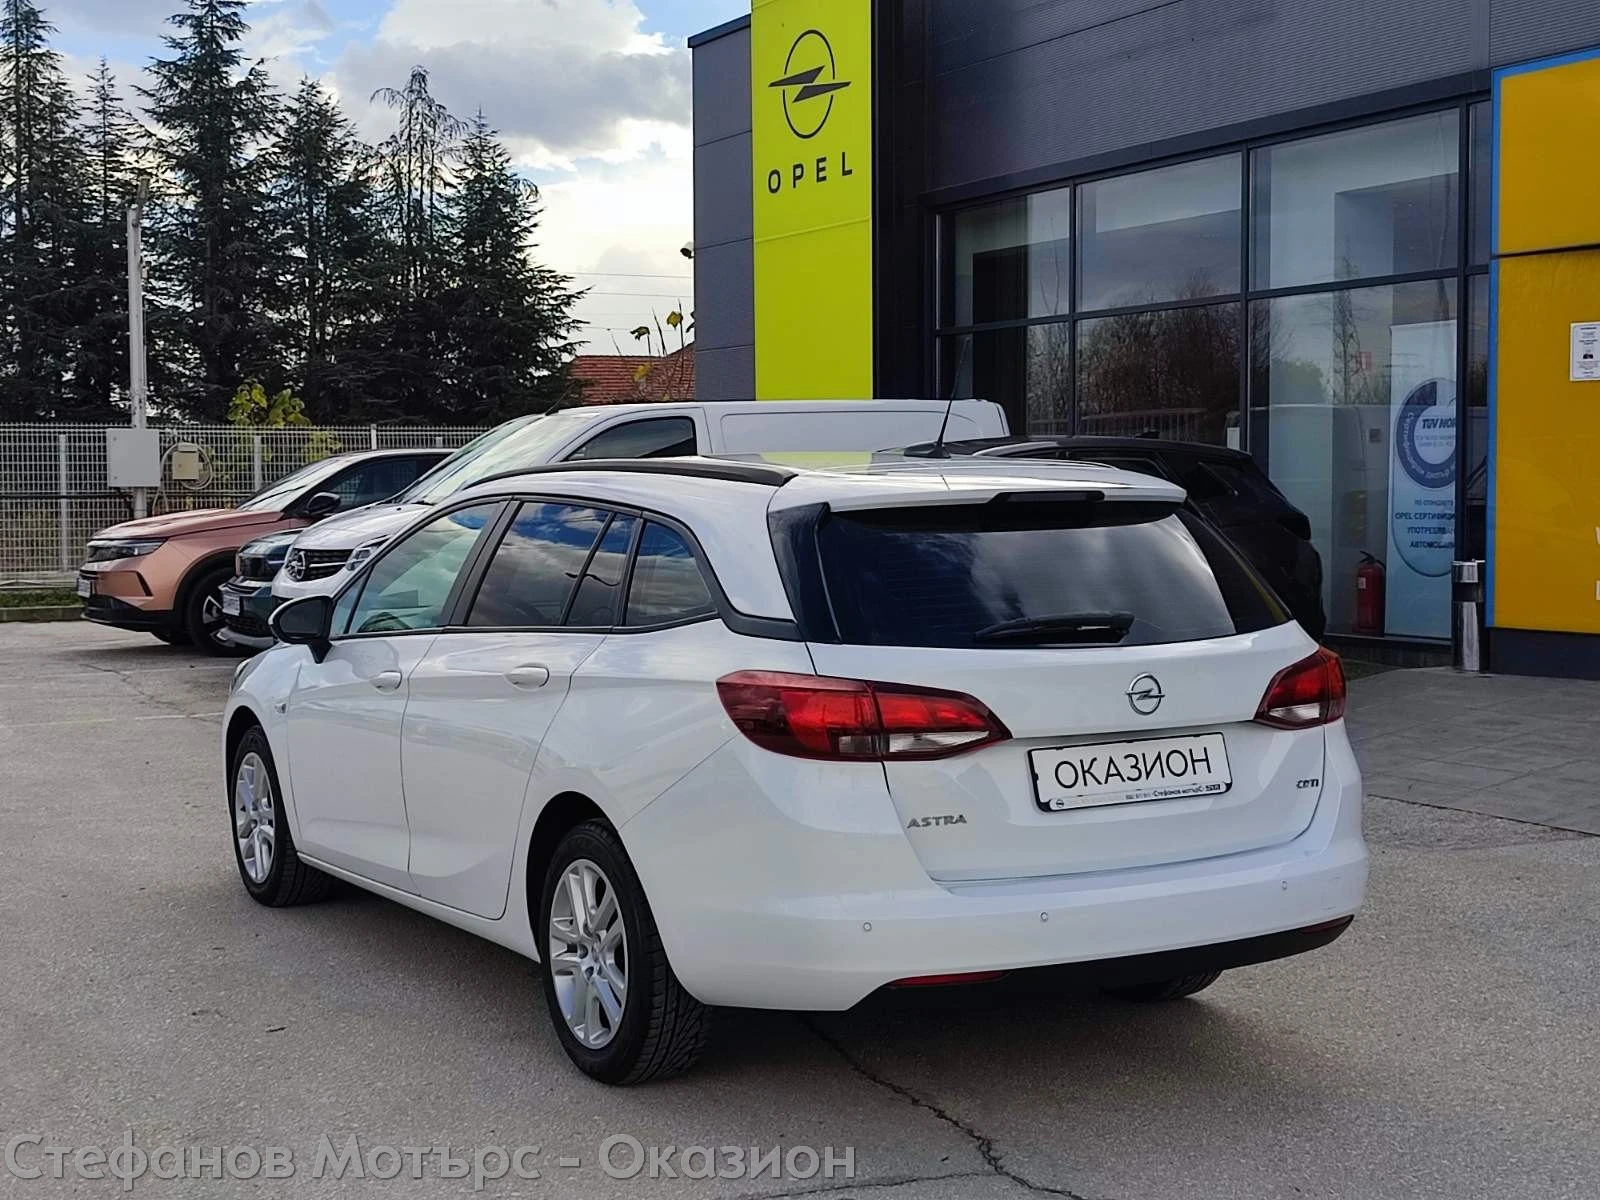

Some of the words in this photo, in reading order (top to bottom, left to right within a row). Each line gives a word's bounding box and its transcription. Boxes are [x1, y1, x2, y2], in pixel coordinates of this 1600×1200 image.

[768, 152, 853, 194] OPEL
[1053, 746, 1212, 790] ОКАЗИОН
[907, 814, 967, 829] ASTRA
